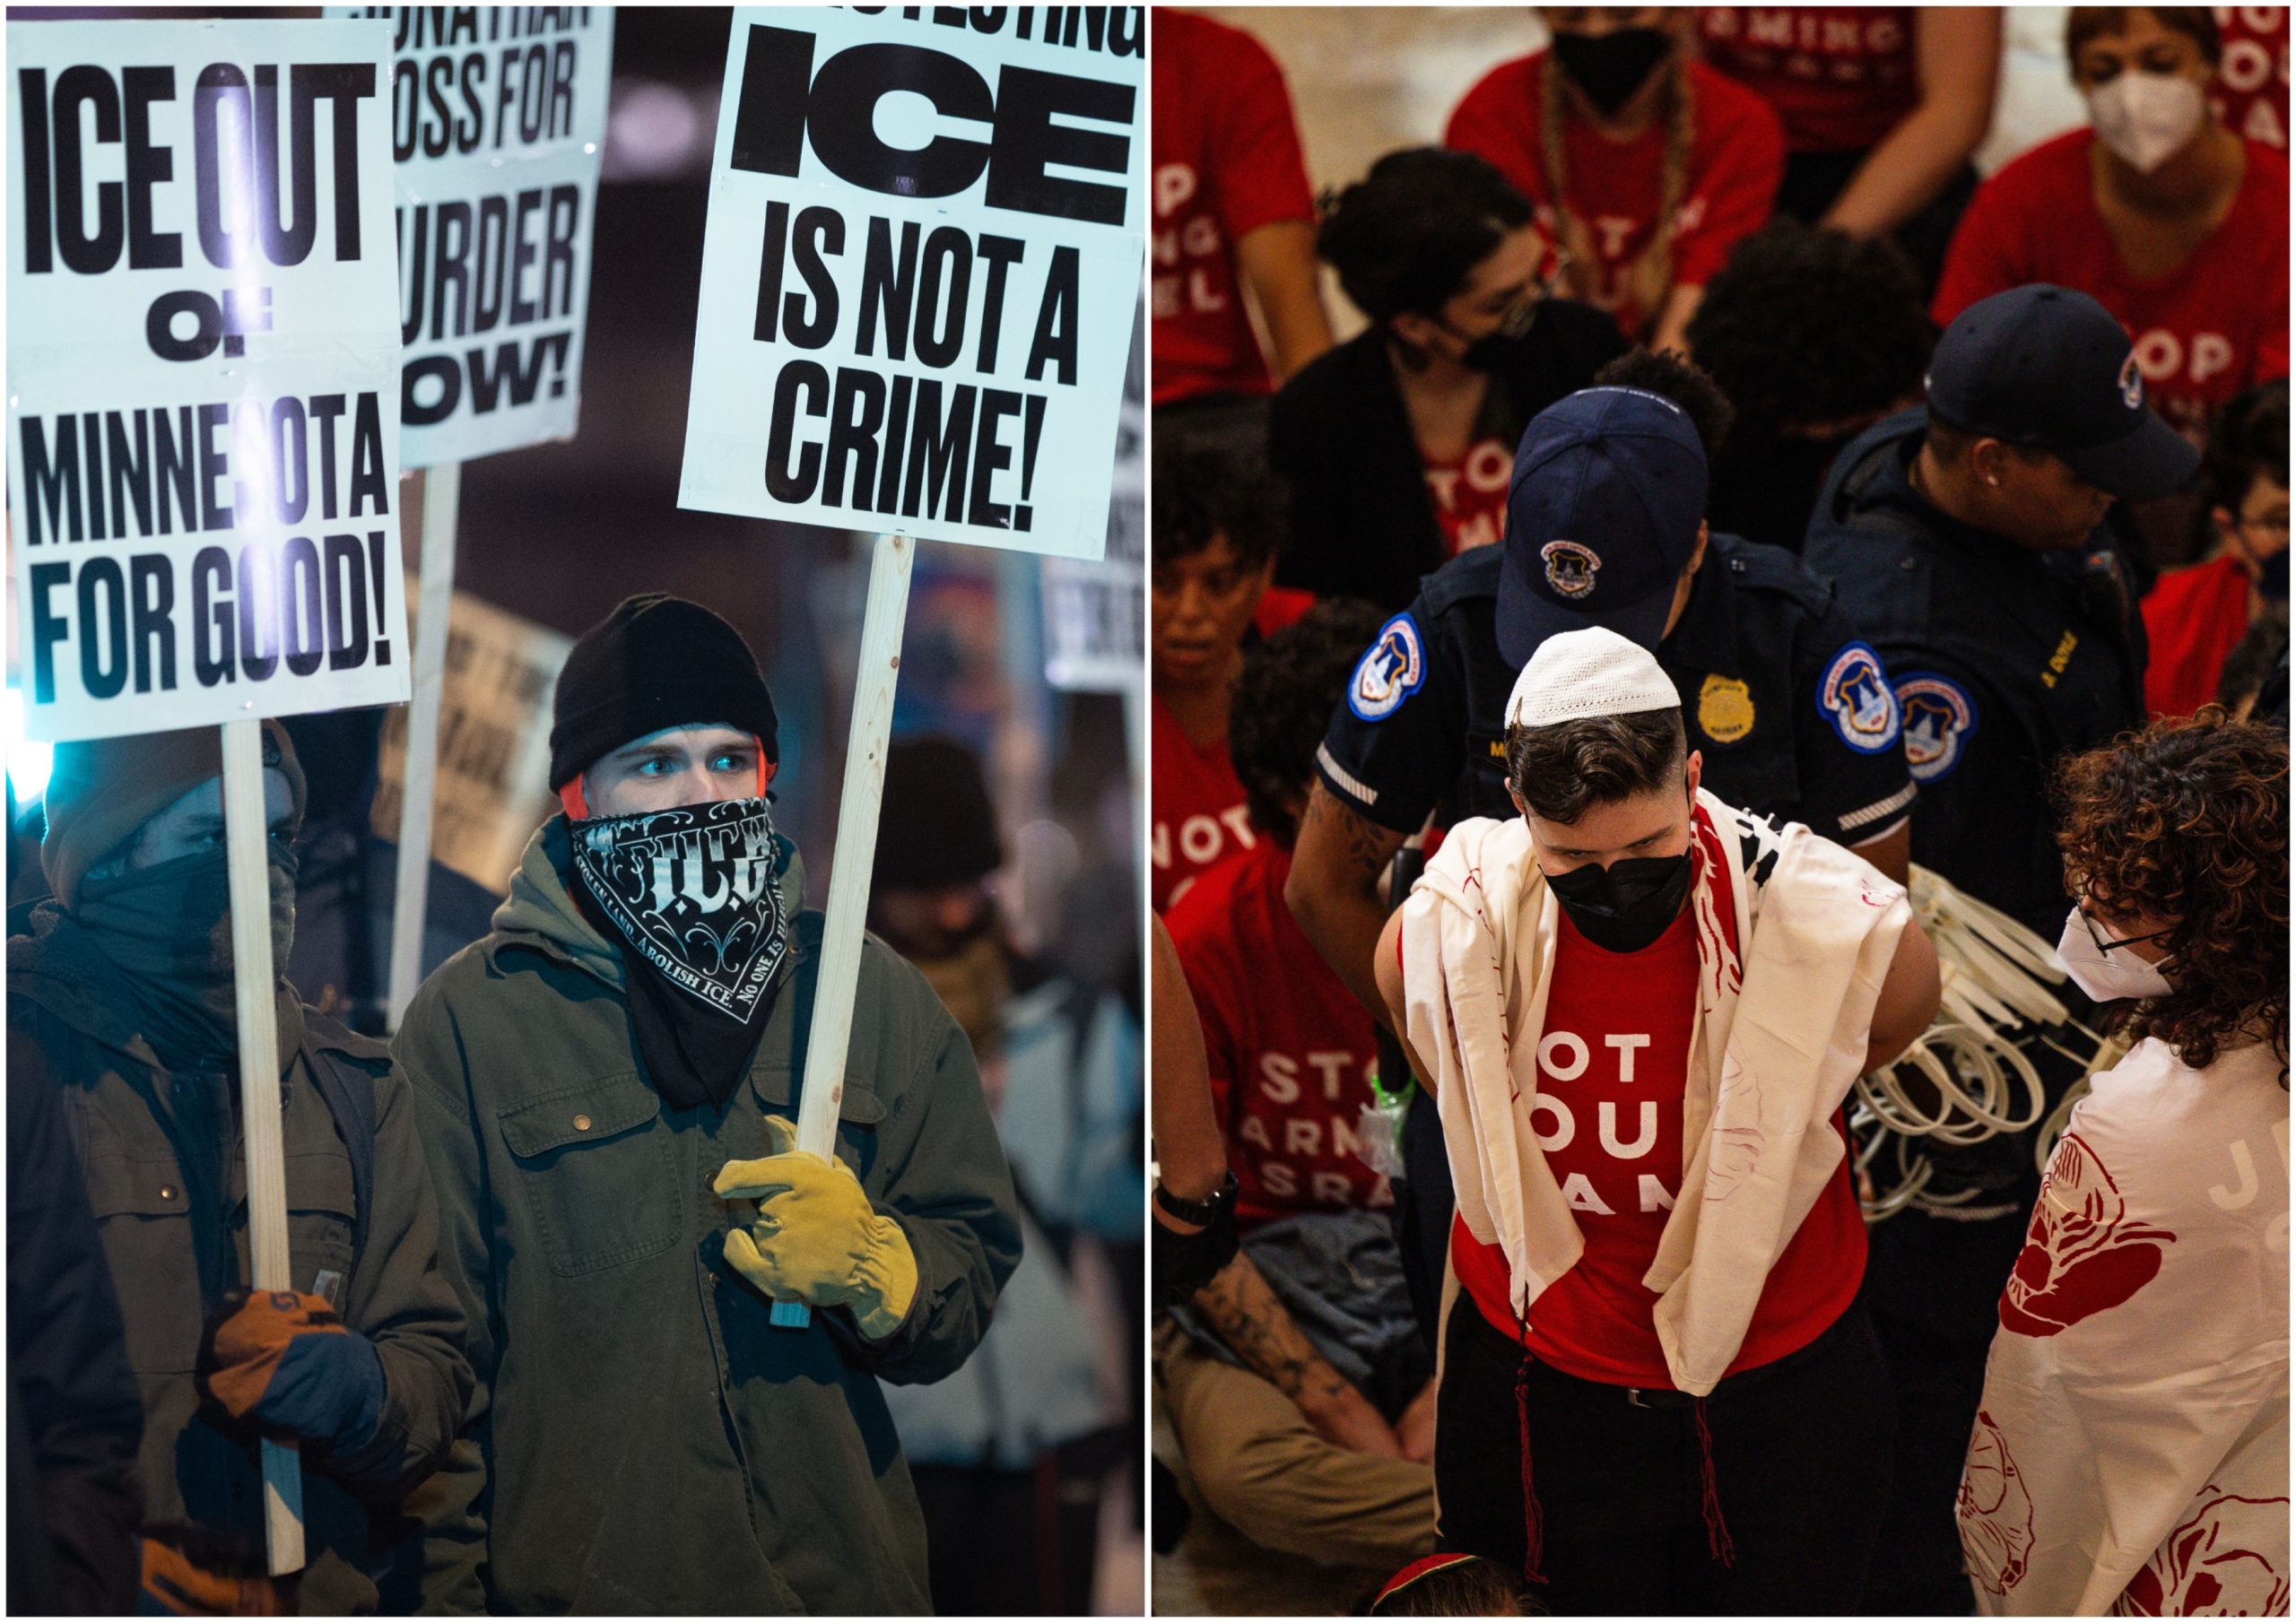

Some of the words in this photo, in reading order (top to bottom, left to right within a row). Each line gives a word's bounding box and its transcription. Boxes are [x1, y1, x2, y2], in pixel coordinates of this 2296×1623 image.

[495, 39, 577, 151] FOR
[730, 24, 1136, 227] ICE
[18, 64, 183, 275] ICE
[193, 62, 377, 269] OUT
[145, 286, 273, 362] OF
[753, 200, 847, 350] IS
[855, 215, 1024, 375] NOT
[1024, 245, 1080, 386] A
[764, 359, 1048, 533] CRIME!
[29, 552, 178, 704] FOR
[191, 531, 393, 688] GOOD!
[637, 936, 700, 988] ABOLISH
[700, 982, 734, 1009] ICE.
[736, 985, 759, 1005] NO
[751, 955, 773, 982] ONE
[767, 939, 783, 957] IS
[1259, 1052, 1379, 1104] ST
